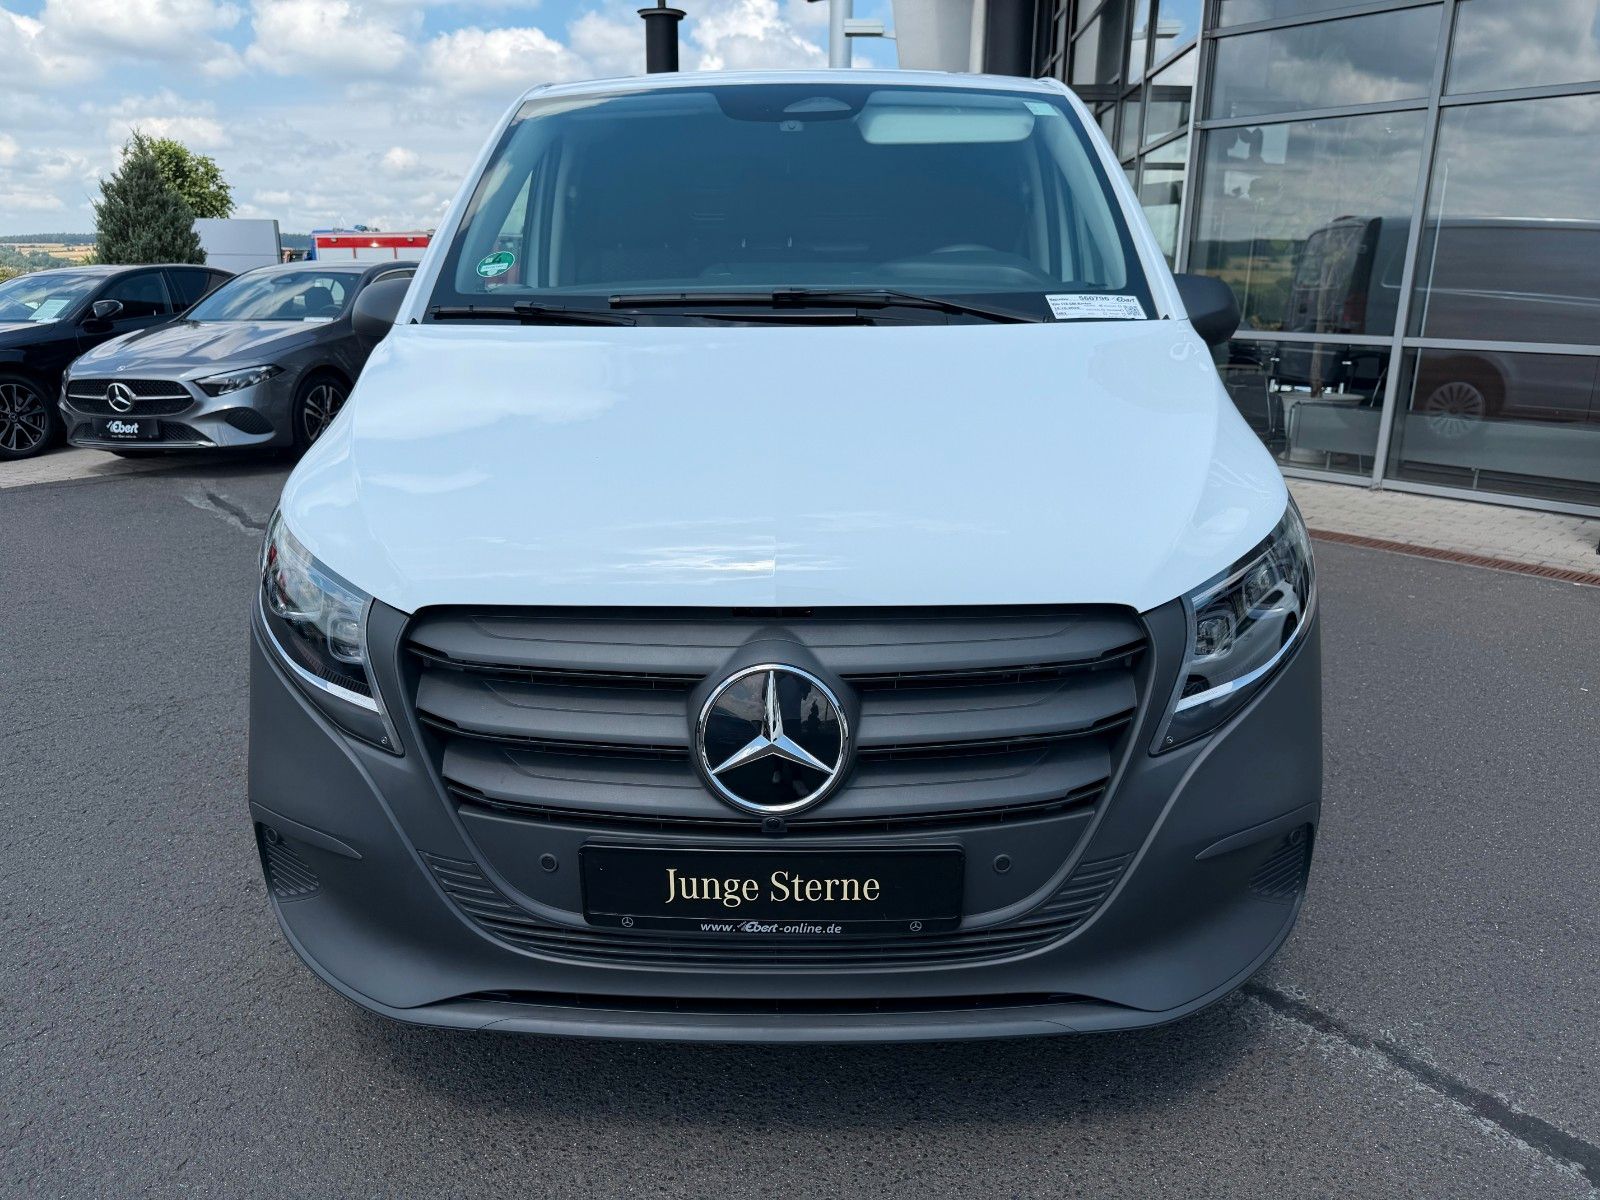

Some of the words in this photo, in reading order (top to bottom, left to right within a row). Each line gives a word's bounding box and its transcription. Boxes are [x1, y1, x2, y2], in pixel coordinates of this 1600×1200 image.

[110, 420, 139, 434] Ebert
[665, 868, 759, 907] Junge
[769, 870, 881, 902] Sterne
[700, 920, 842, 934] www.Ebert-online.de
